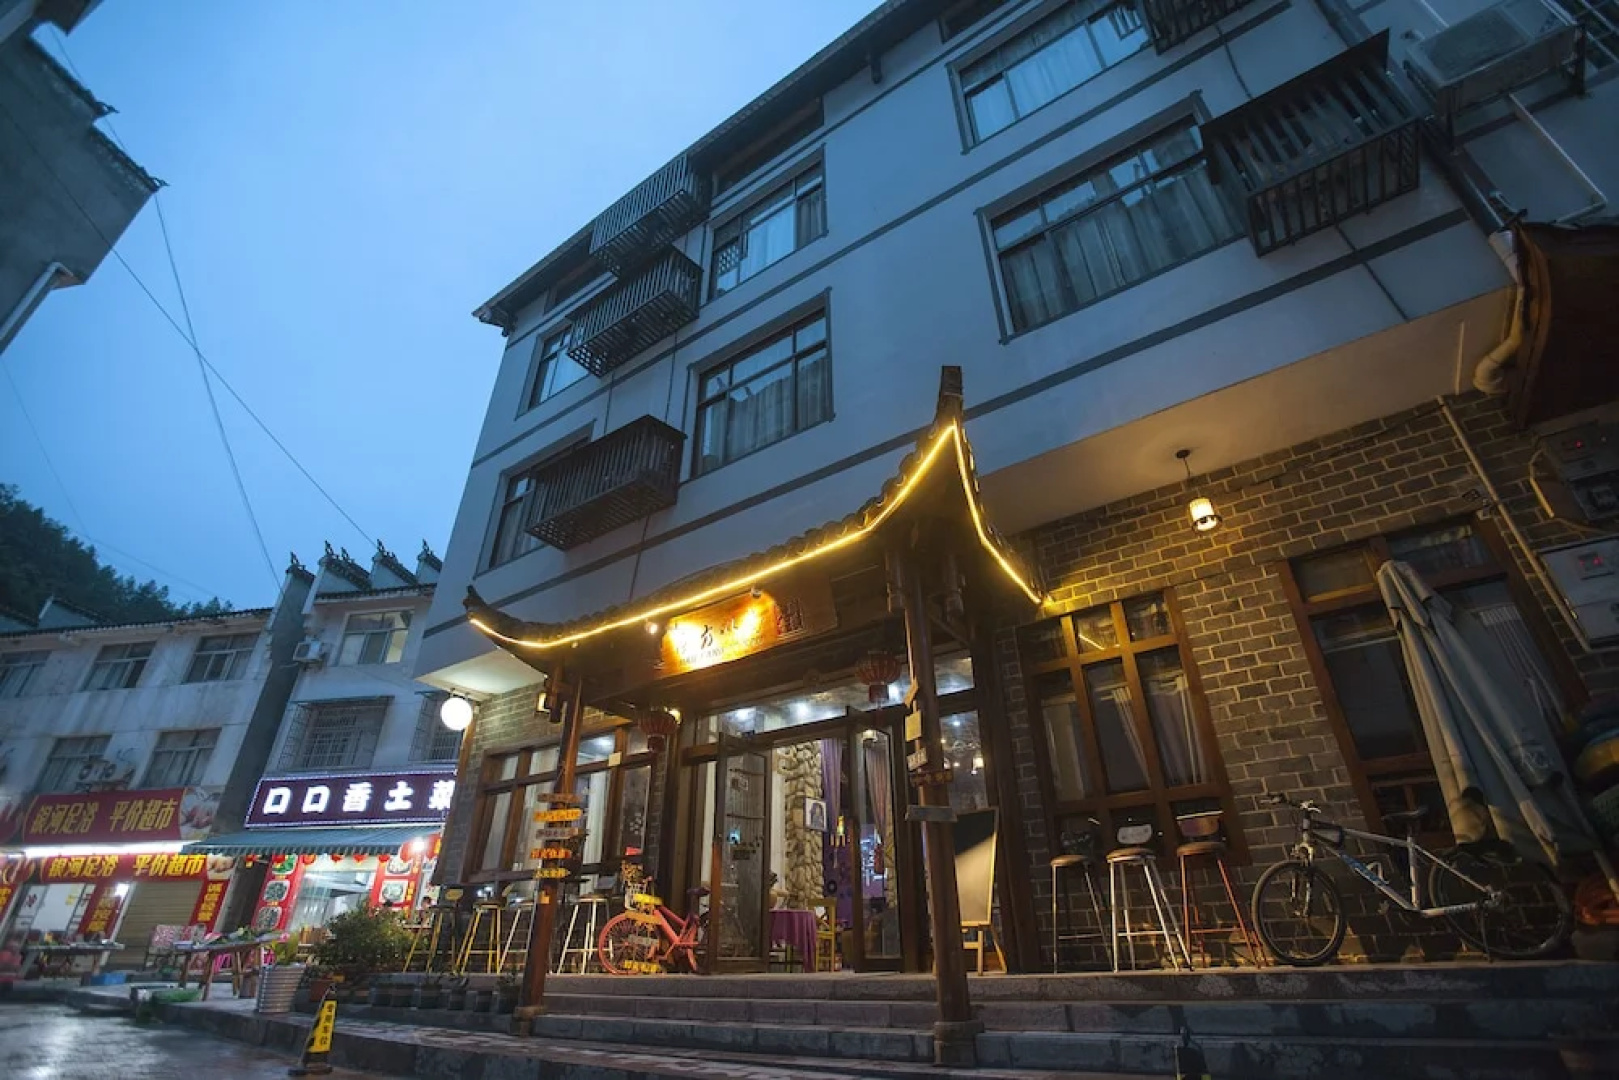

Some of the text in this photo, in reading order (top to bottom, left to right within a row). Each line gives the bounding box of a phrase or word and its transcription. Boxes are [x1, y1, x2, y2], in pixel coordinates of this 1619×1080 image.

[109, 798, 178, 832] 平价超市
[48, 854, 205, 877] 银河足浴 平价超市
